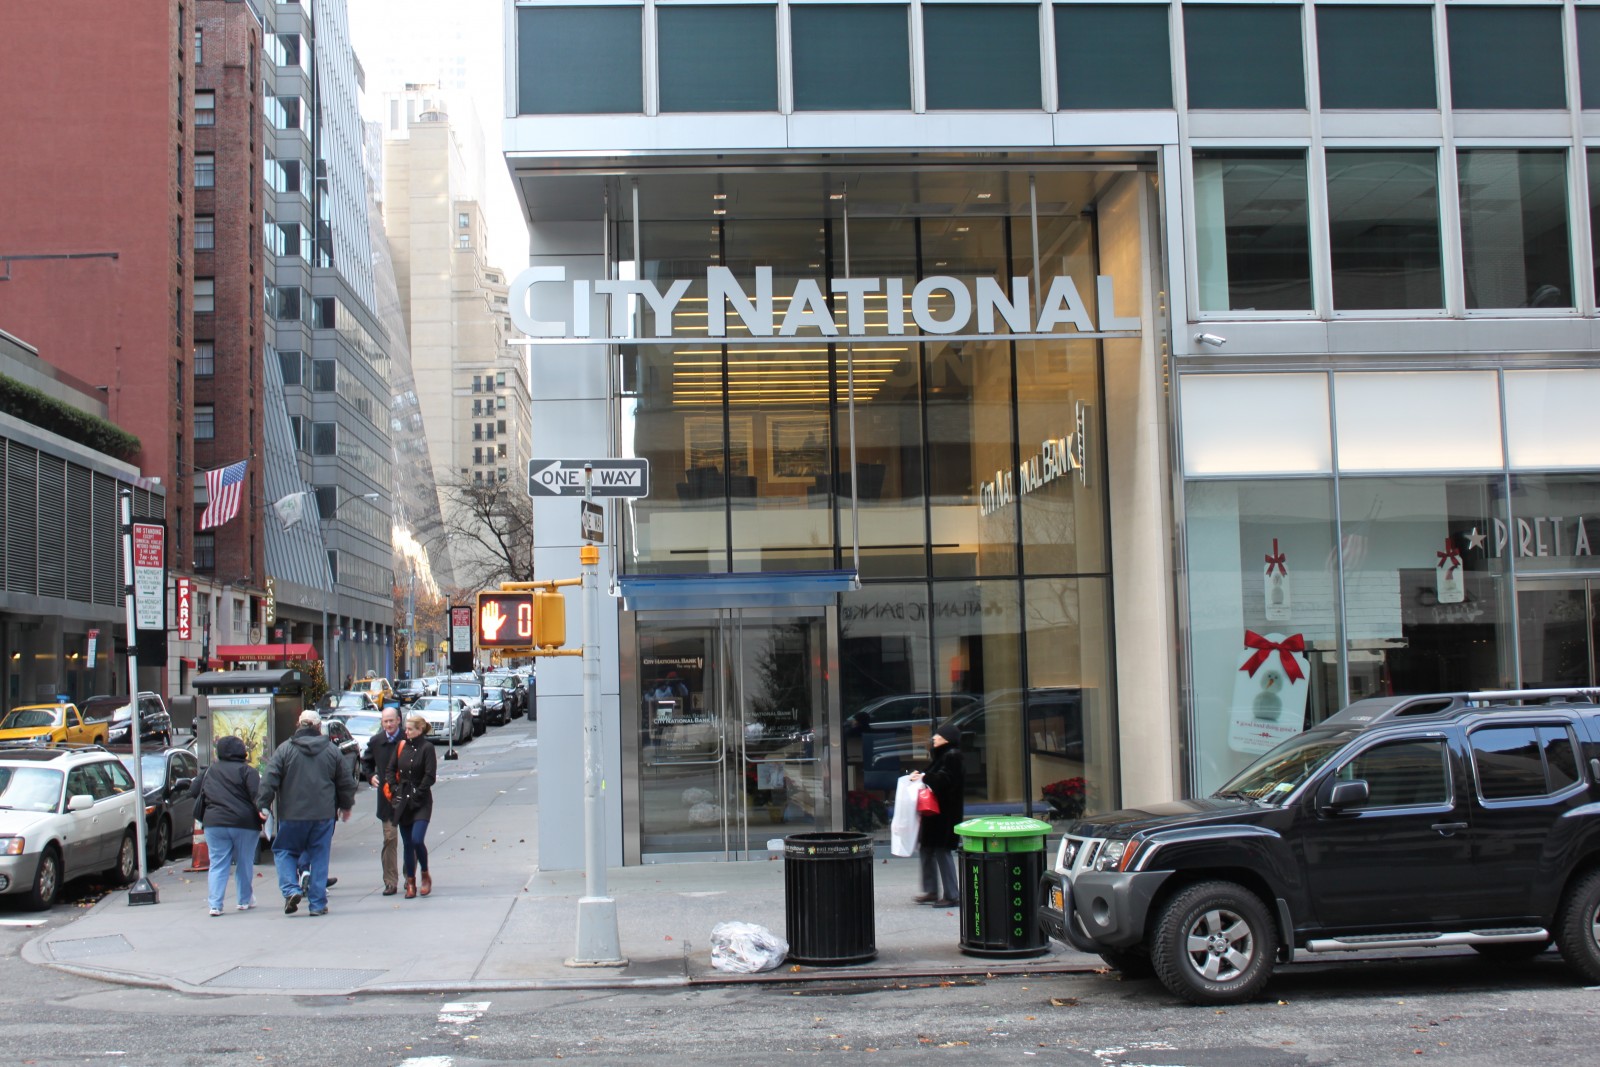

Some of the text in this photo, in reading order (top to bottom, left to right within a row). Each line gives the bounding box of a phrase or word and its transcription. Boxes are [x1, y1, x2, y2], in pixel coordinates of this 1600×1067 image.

[508, 266, 1142, 338] CITY NATIONAL
[542, 471, 636, 485] ONE WAY
[1042, 431, 1080, 484] BANK
[1493, 516, 1592, 558] PRET A
[180, 587, 189, 628] PARK
[266, 578, 274, 615] PARK
[972, 865, 980, 936] MAGAZINES
